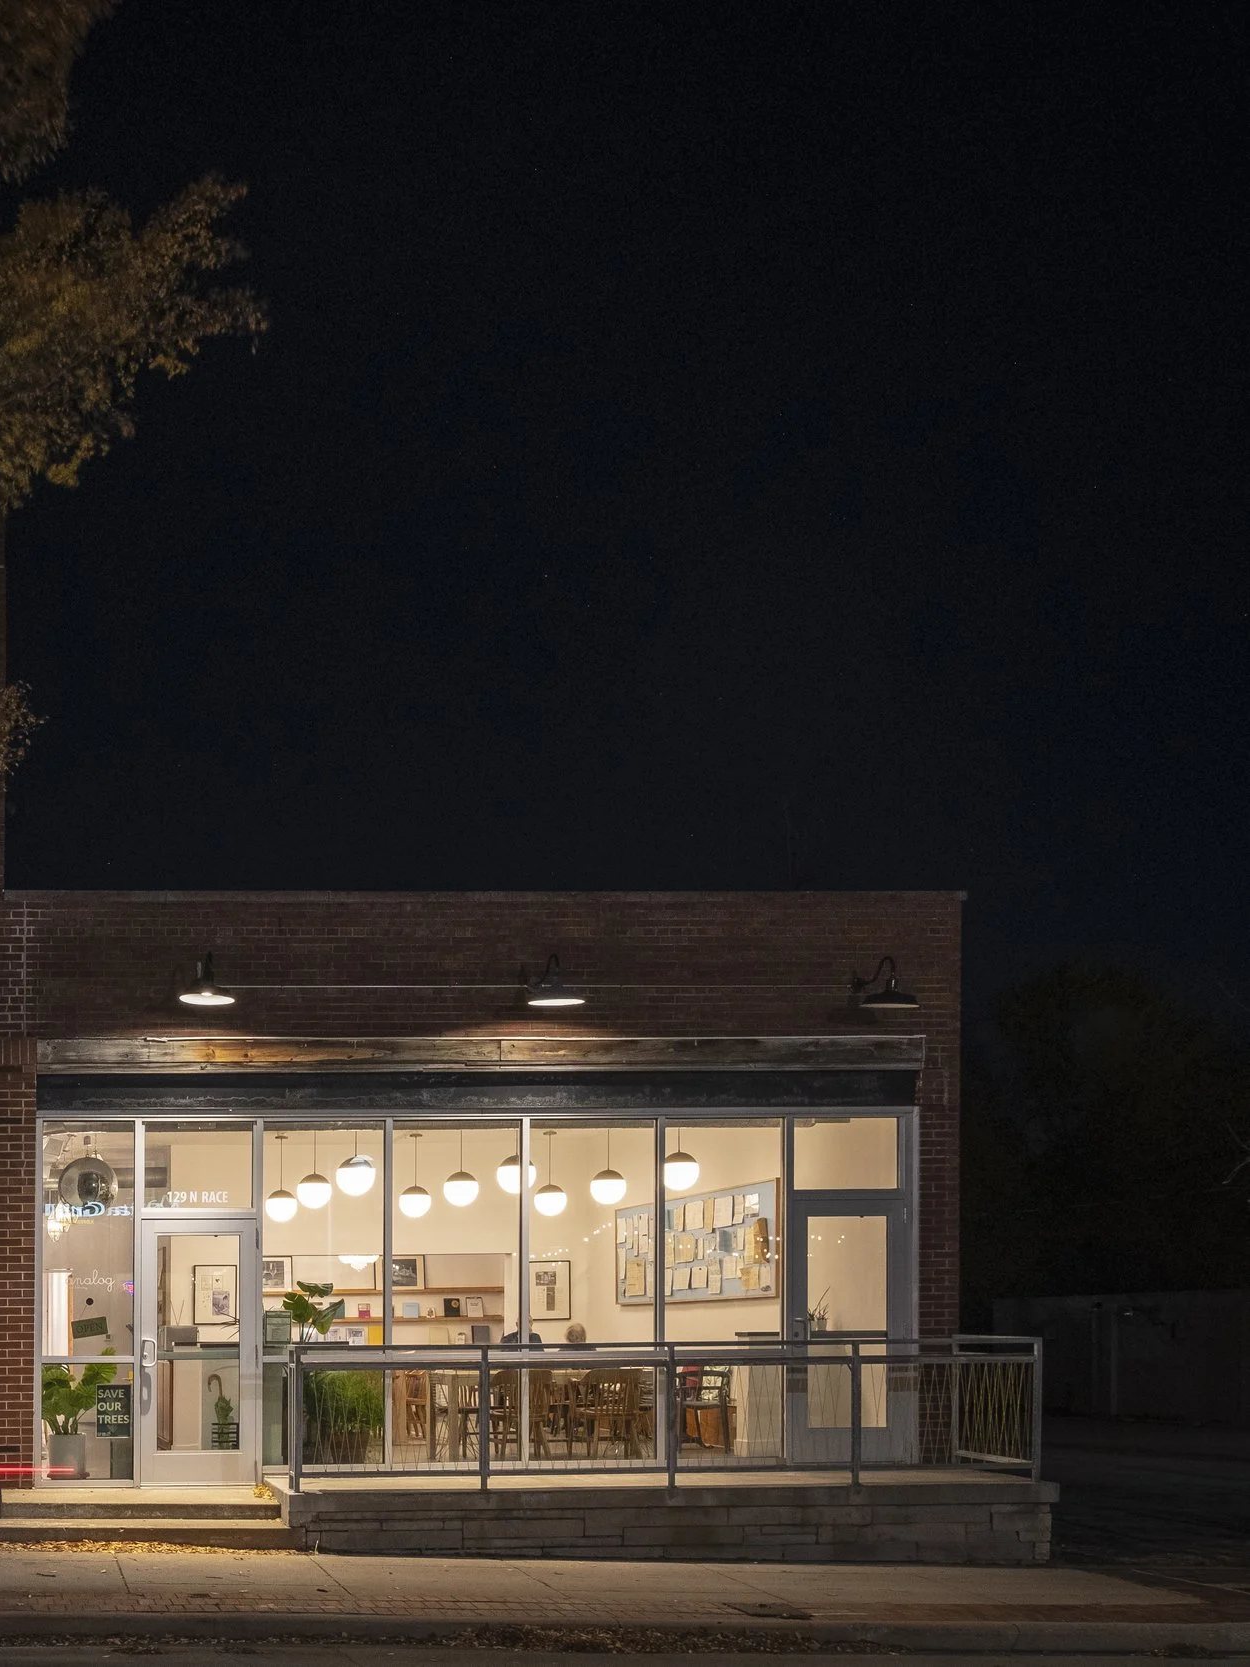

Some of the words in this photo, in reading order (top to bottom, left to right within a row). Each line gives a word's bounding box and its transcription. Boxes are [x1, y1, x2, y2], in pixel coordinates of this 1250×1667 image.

[167, 1191, 187, 1203] 129
[189, 1191, 198, 1203] N
[201, 1191, 228, 1203] RACE
[75, 1321, 104, 1334] OPEN
[97, 1389, 125, 1399] SAVE
[97, 1402, 122, 1411] OUR
[97, 1415, 130, 1424] TREES
